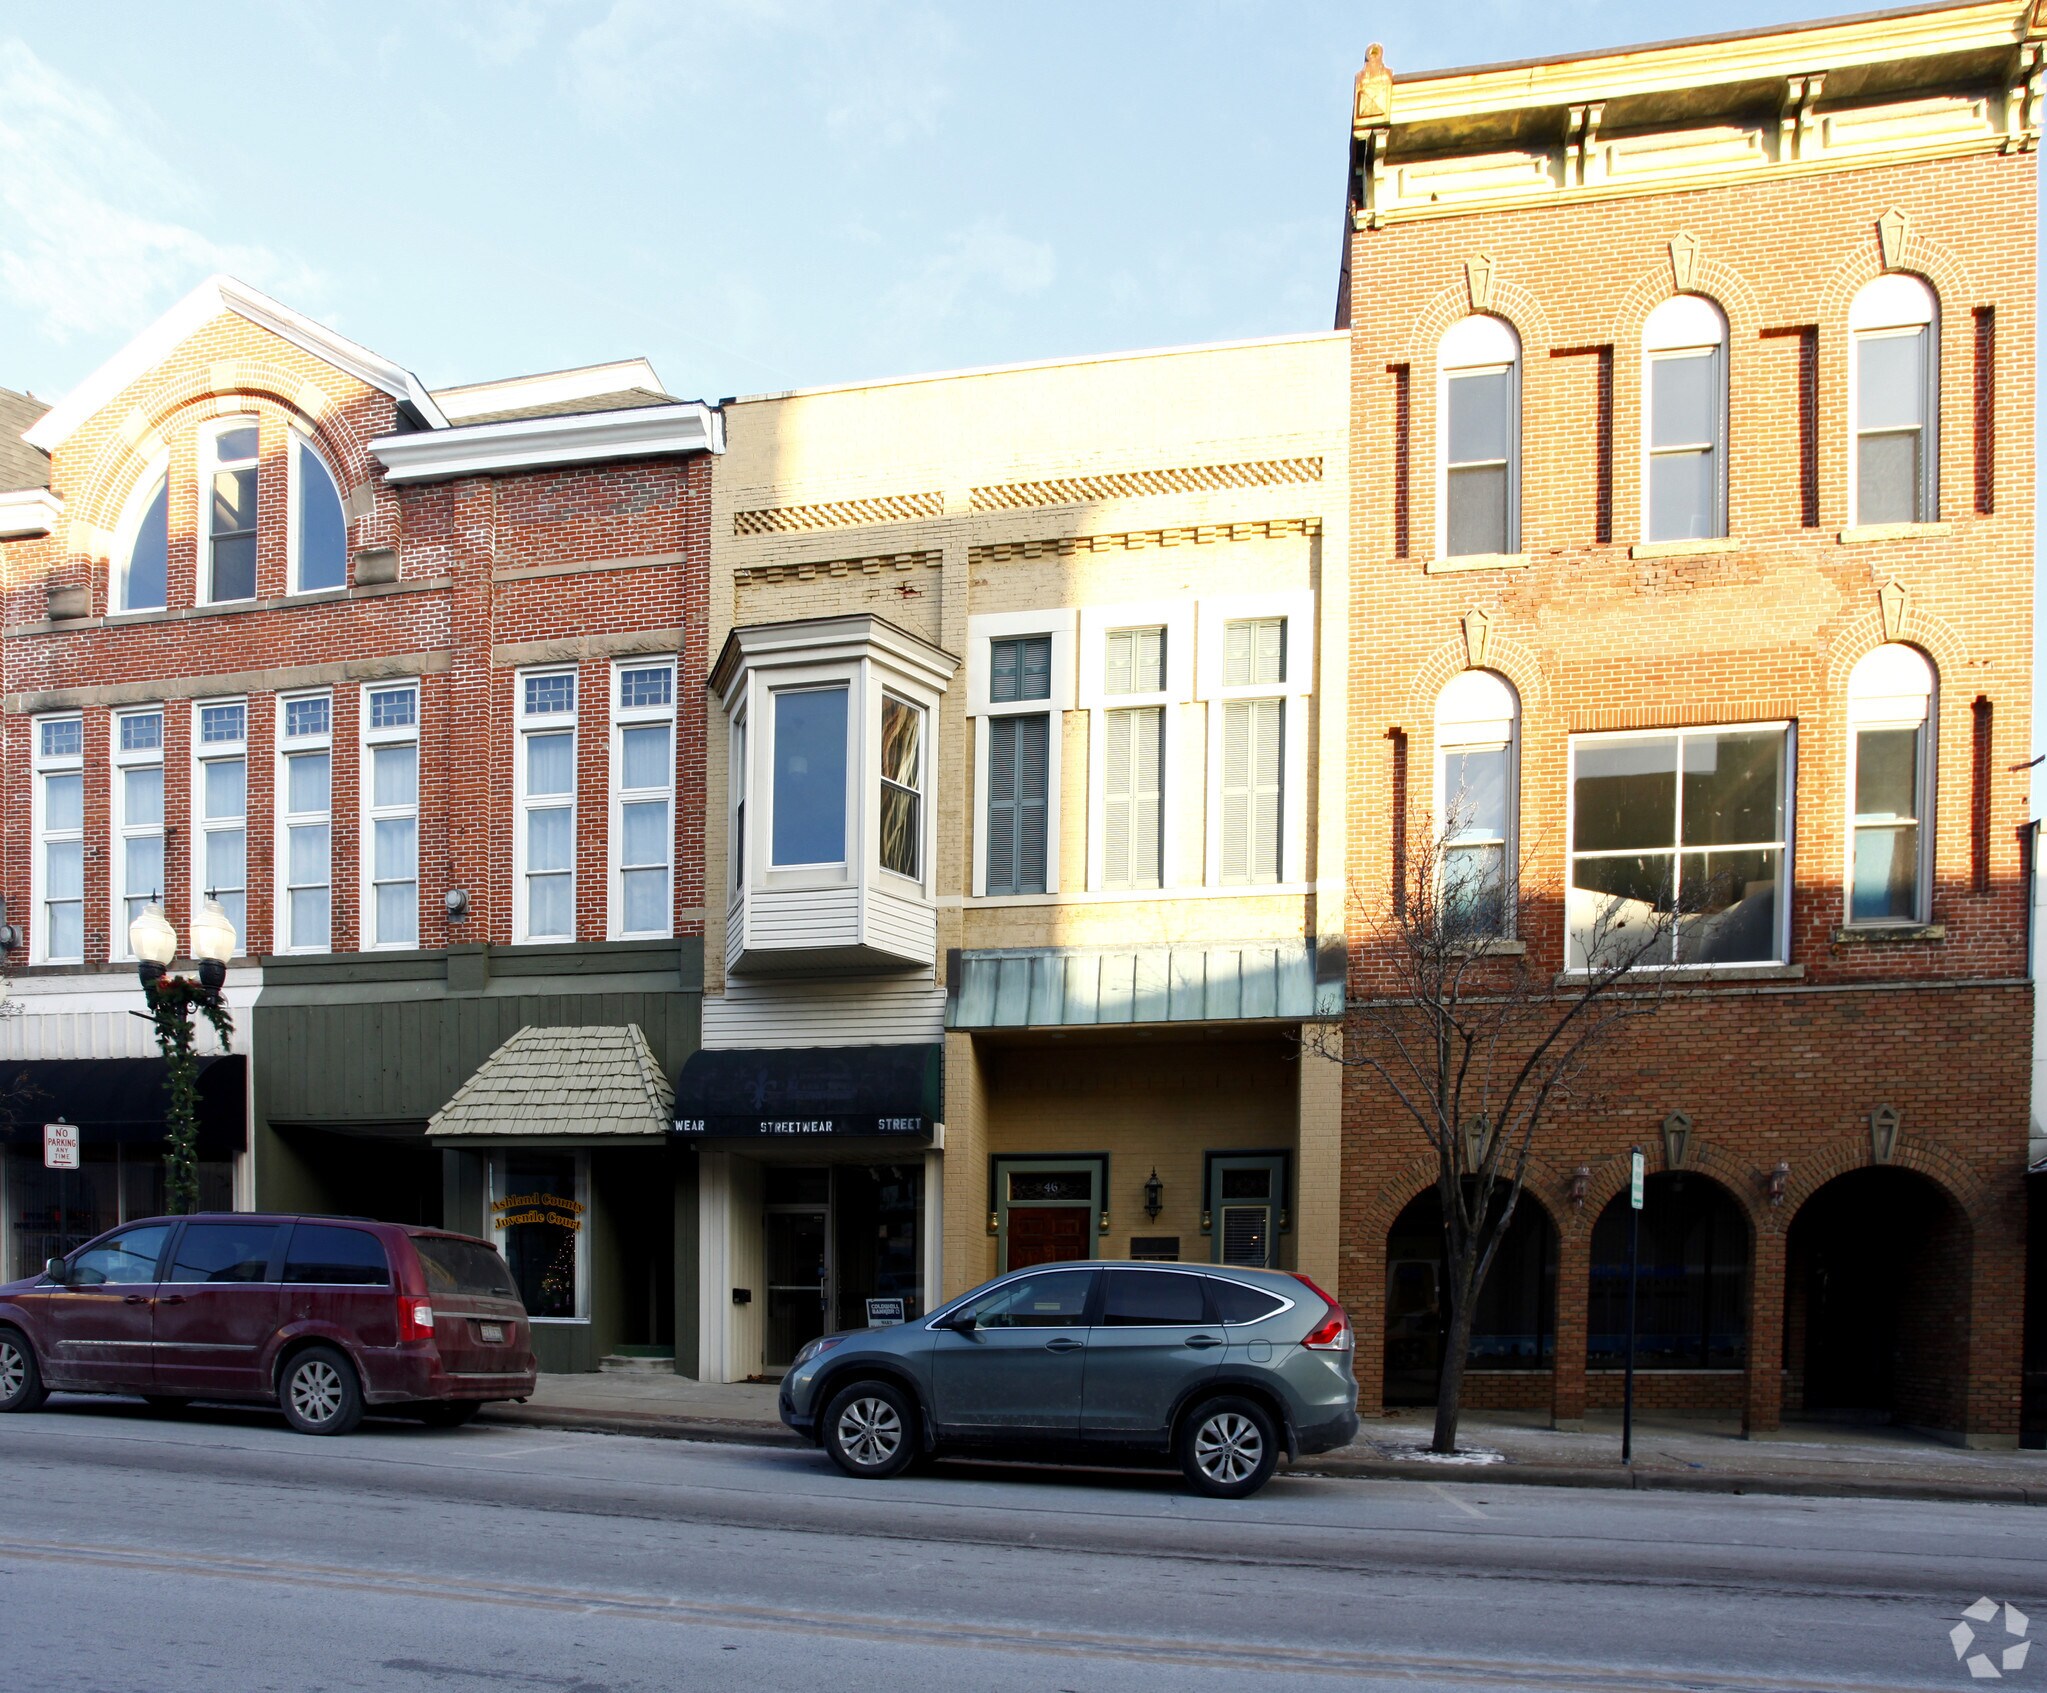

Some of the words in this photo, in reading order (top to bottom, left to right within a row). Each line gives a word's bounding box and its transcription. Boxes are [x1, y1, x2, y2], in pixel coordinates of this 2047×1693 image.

[673, 1119, 705, 1131] WEAR
[760, 1121, 833, 1133] STREETWEAR
[878, 1117, 922, 1130] STREET
[55, 1128, 68, 1137] NO
[48, 1138, 76, 1147] PARKING
[1044, 1182, 1058, 1193] 46
[491, 1192, 539, 1212] Ashland
[541, 1193, 586, 1214] County
[495, 1210, 545, 1229] Juvenile
[546, 1211, 583, 1231] Court
